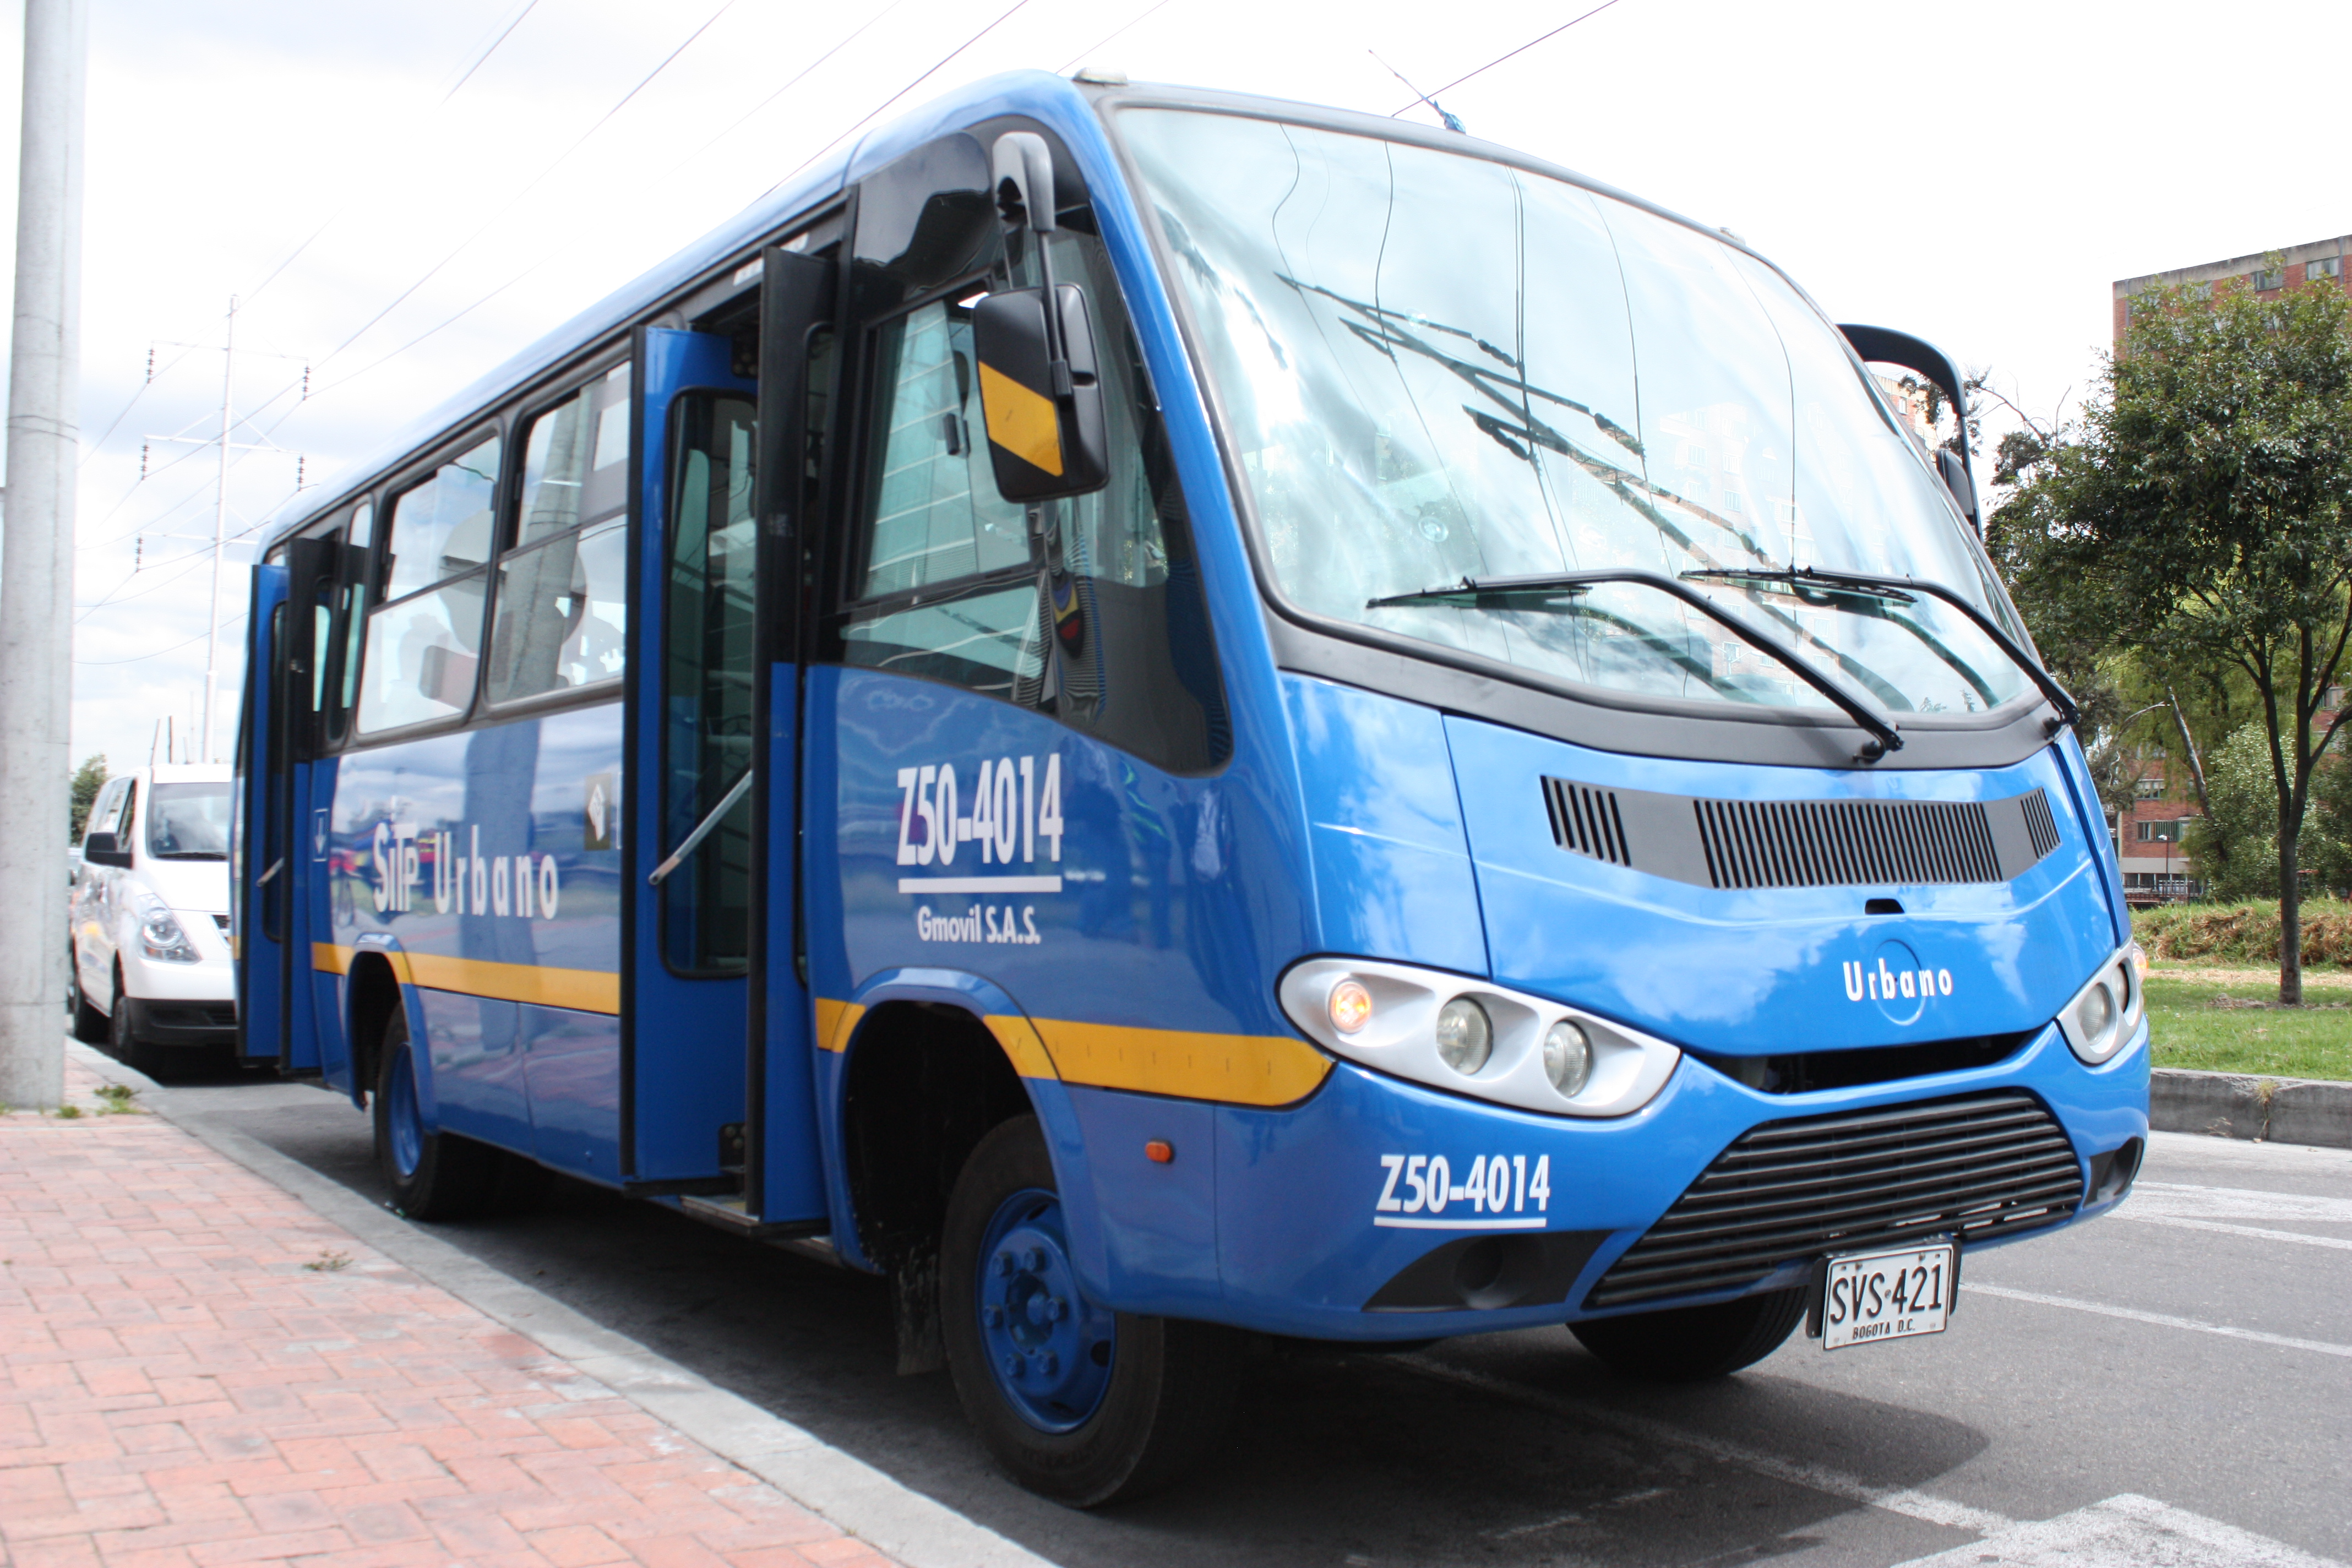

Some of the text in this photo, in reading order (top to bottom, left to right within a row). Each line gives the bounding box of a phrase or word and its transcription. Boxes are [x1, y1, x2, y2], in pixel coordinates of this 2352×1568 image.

[896, 753, 1063, 866] Z50-4014
[433, 824, 559, 921] Urbano
[917, 905, 1041, 944] Gmovil S.A.S.
[1843, 958, 1953, 1001] Urbano
[1376, 1154, 1550, 1213] Z50-4014
[1852, 1318, 1916, 1340] BOGOTA D.C.
